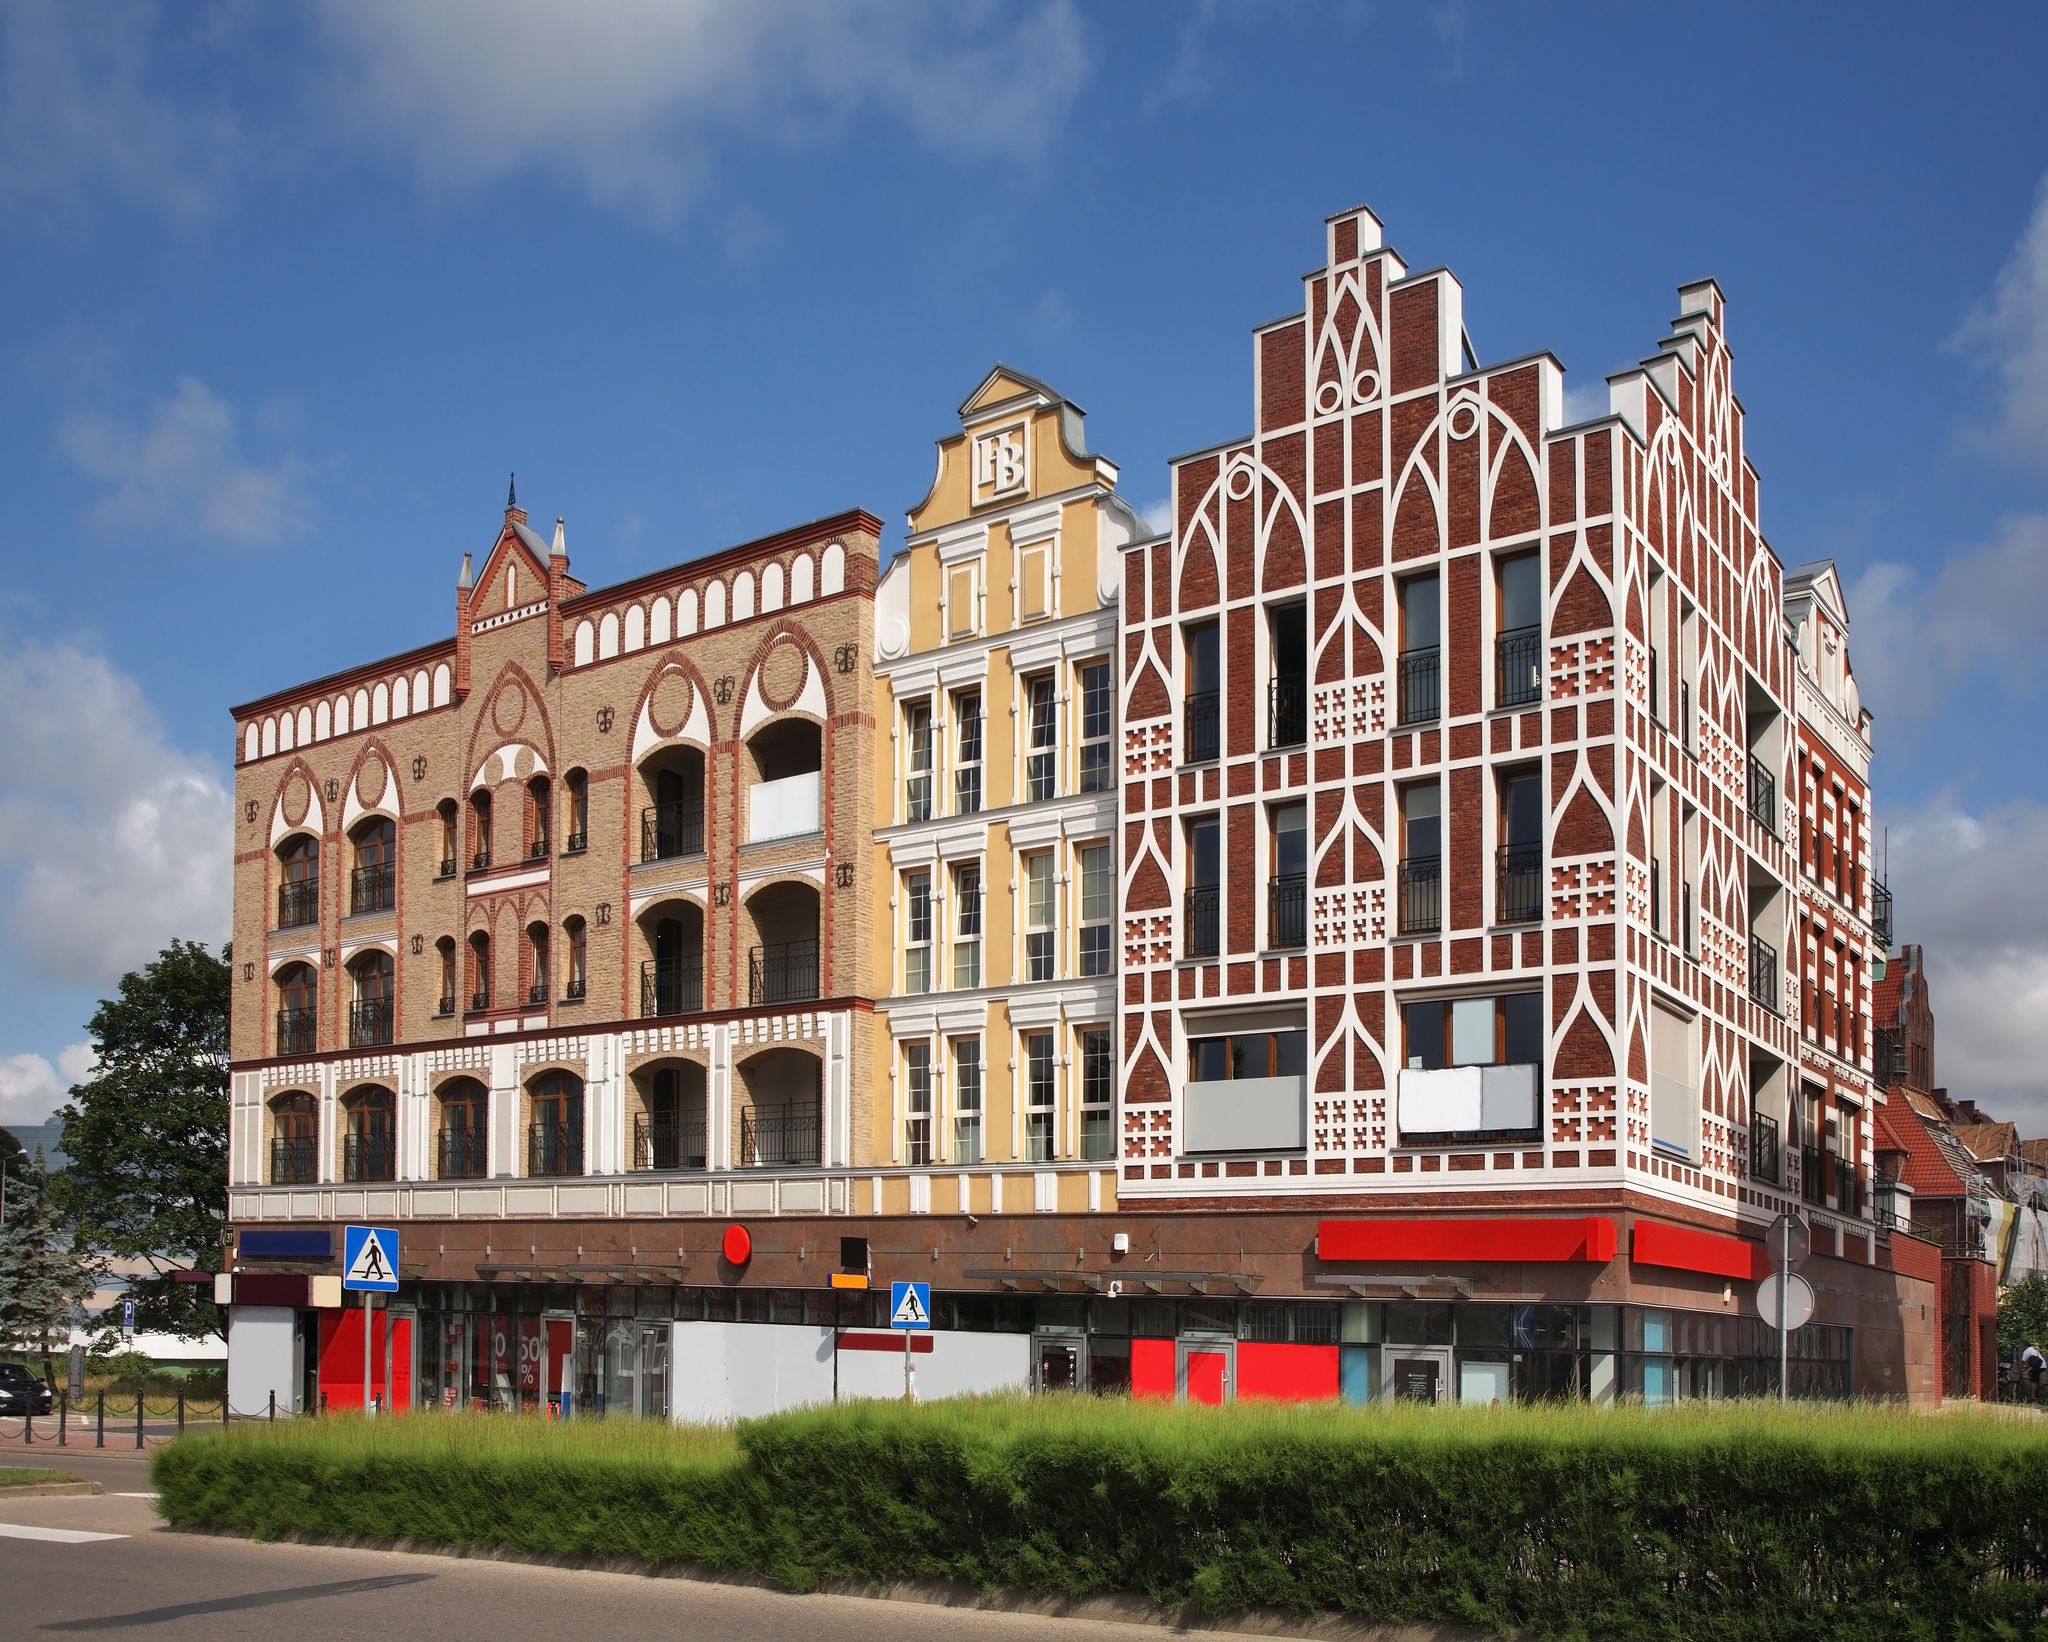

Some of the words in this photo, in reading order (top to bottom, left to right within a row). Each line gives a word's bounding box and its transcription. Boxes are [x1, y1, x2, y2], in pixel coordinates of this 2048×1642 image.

[125, 1301, 132, 1319] P
[521, 1336, 541, 1361] 50
[521, 1364, 534, 1384] %
